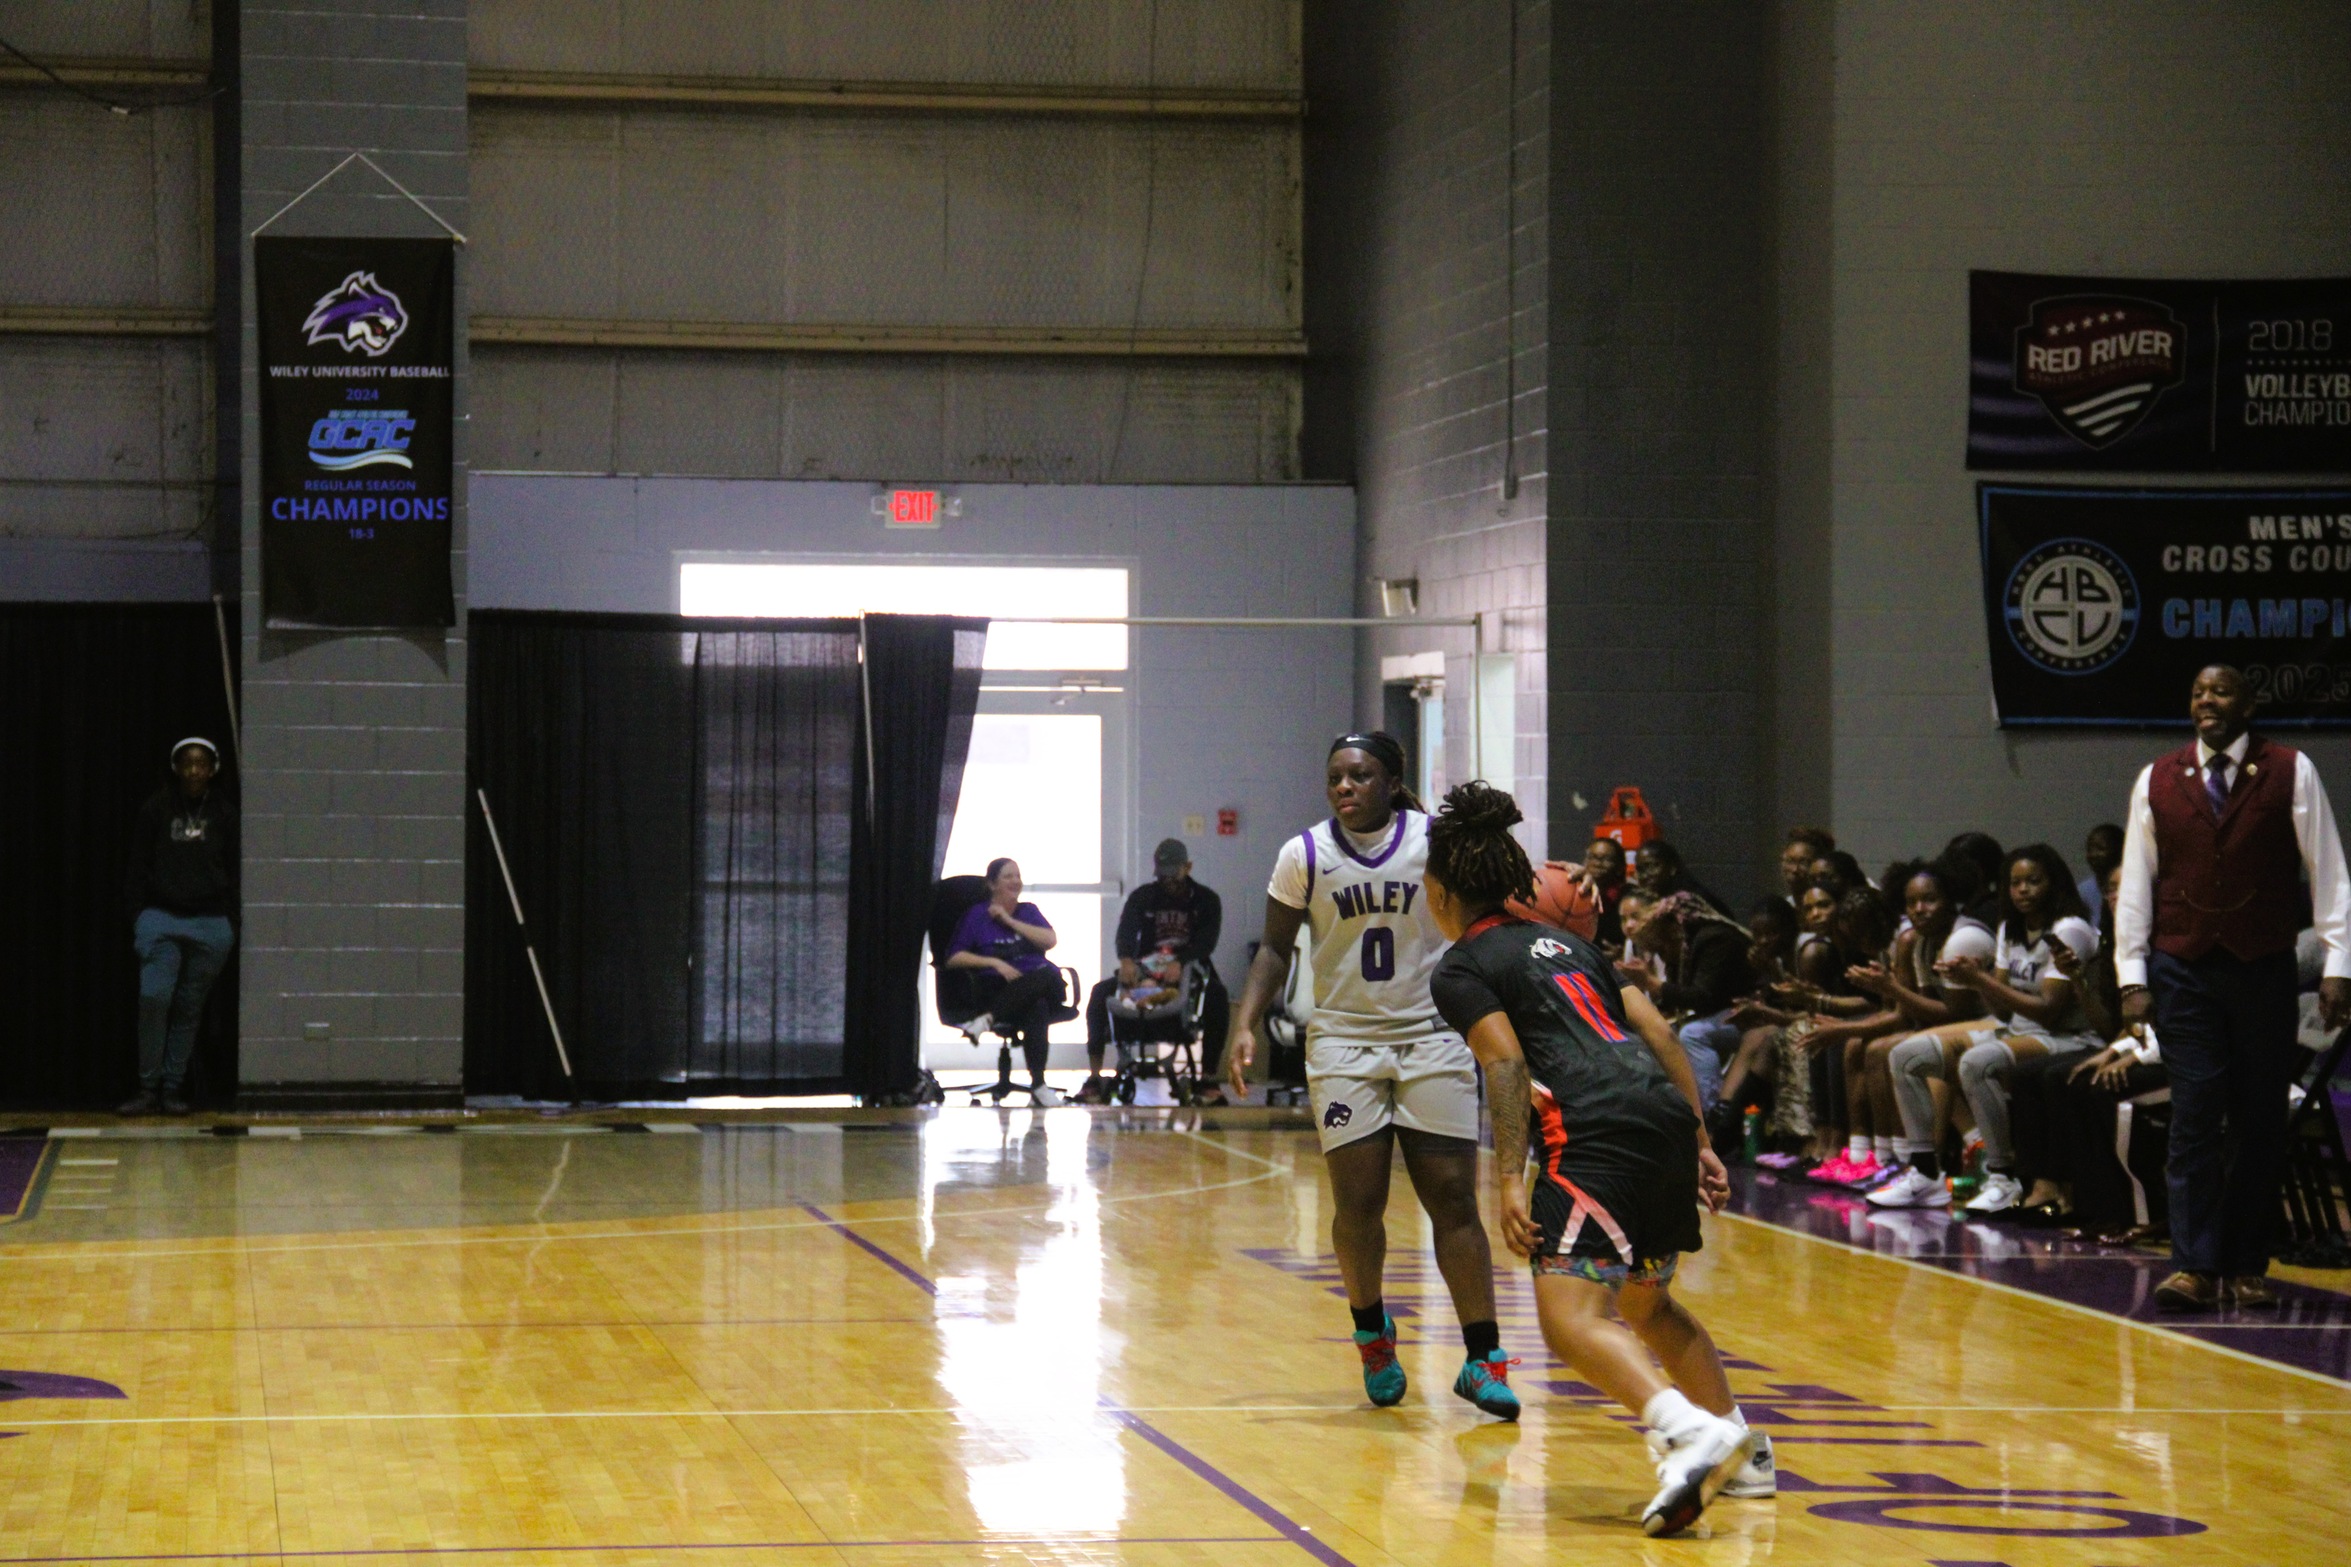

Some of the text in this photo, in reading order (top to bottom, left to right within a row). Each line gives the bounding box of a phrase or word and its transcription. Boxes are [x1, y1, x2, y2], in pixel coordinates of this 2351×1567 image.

[2248, 318, 2333, 351] 2018
[2028, 329, 2173, 373] RED RIVER
[269, 366, 450, 378] WILEY UNIVERSITY BASEBALL
[346, 388, 379, 400] 2024
[307, 418, 416, 449] GCAC
[304, 480, 416, 491] REGULAR SEASON
[271, 497, 448, 521] CHAMPIONS
[895, 491, 935, 522] EXIT
[350, 528, 375, 540] 18-3
[2249, 514, 2351, 540] MEN'S
[2162, 545, 2272, 572] CROSS
[2162, 598, 2351, 639] CHAMPI
[1331, 881, 1420, 922] WILEY
[1360, 926, 1396, 983] 0
[1553, 971, 1628, 1043] 11
